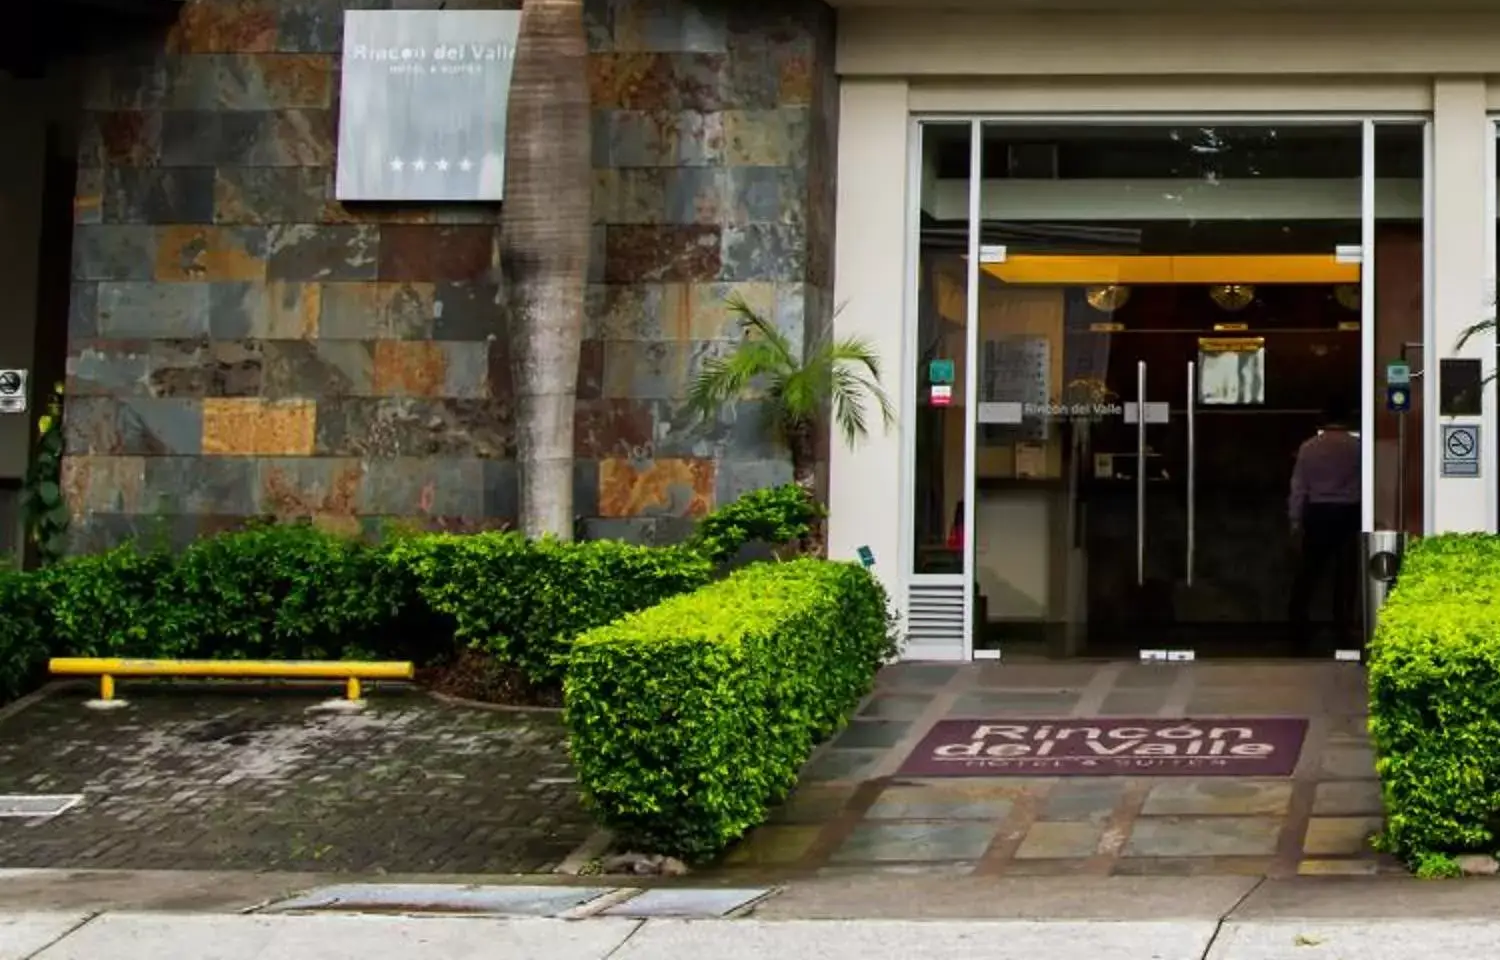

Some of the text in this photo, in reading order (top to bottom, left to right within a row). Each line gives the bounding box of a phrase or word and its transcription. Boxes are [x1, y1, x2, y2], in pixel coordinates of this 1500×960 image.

[434, 43, 464, 60] del
[971, 724, 1252, 740] Rincón
[933, 740, 1275, 756] del Valle
